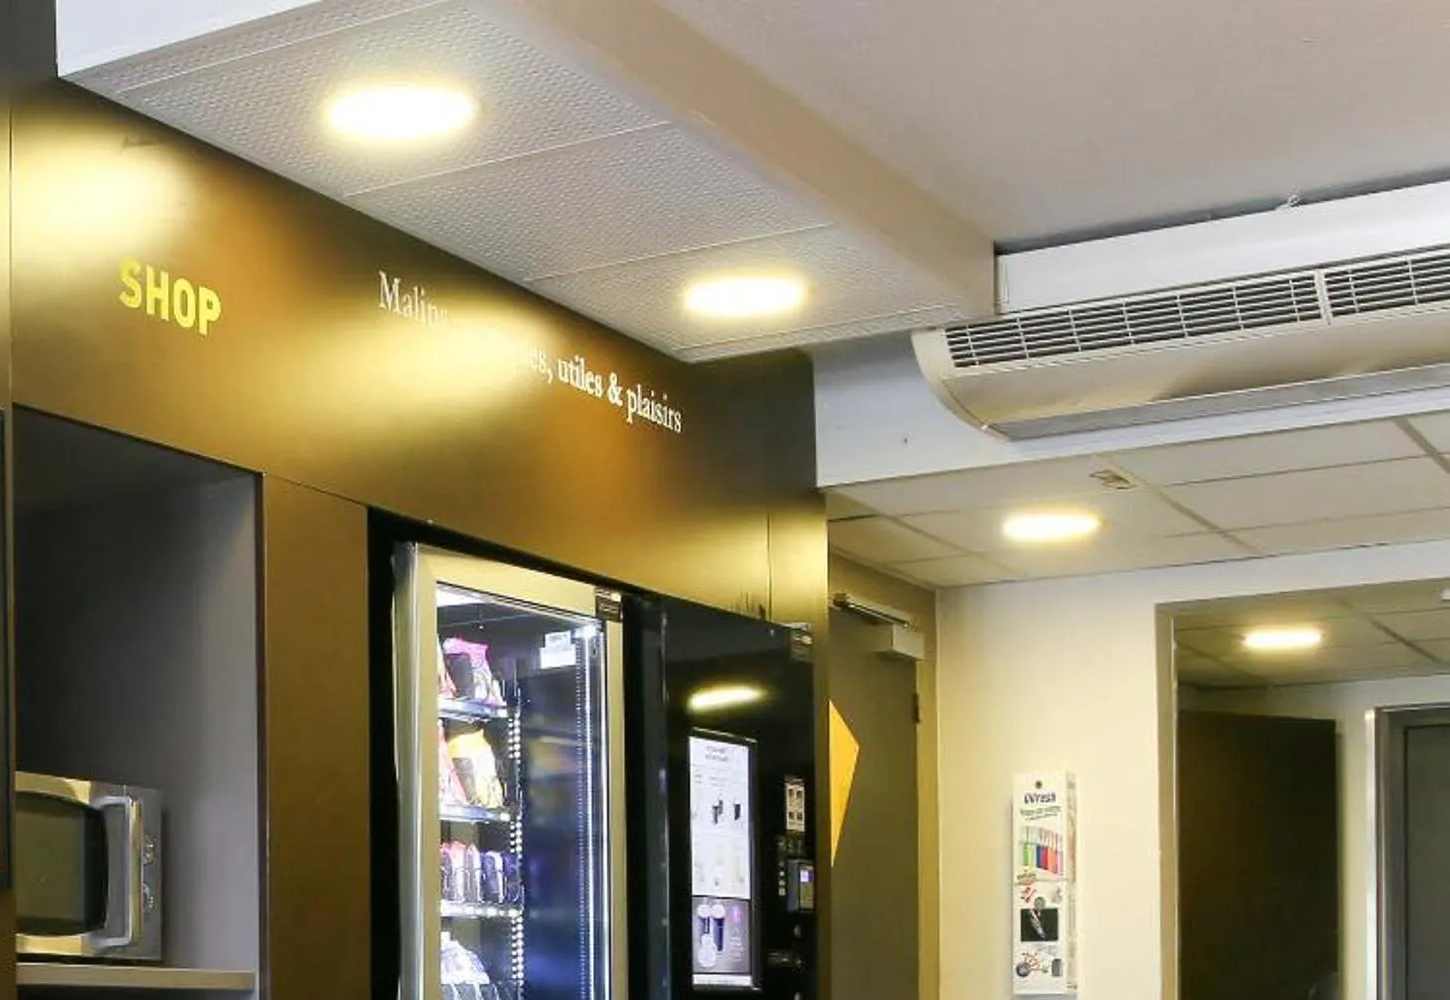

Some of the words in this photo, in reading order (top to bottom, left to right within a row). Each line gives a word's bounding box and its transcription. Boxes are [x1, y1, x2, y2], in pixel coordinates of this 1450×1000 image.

[118, 257, 222, 337] SHOP
[557, 355, 603, 399] utiles
[607, 371, 623, 407] &
[626, 383, 682, 434] plaisirs
